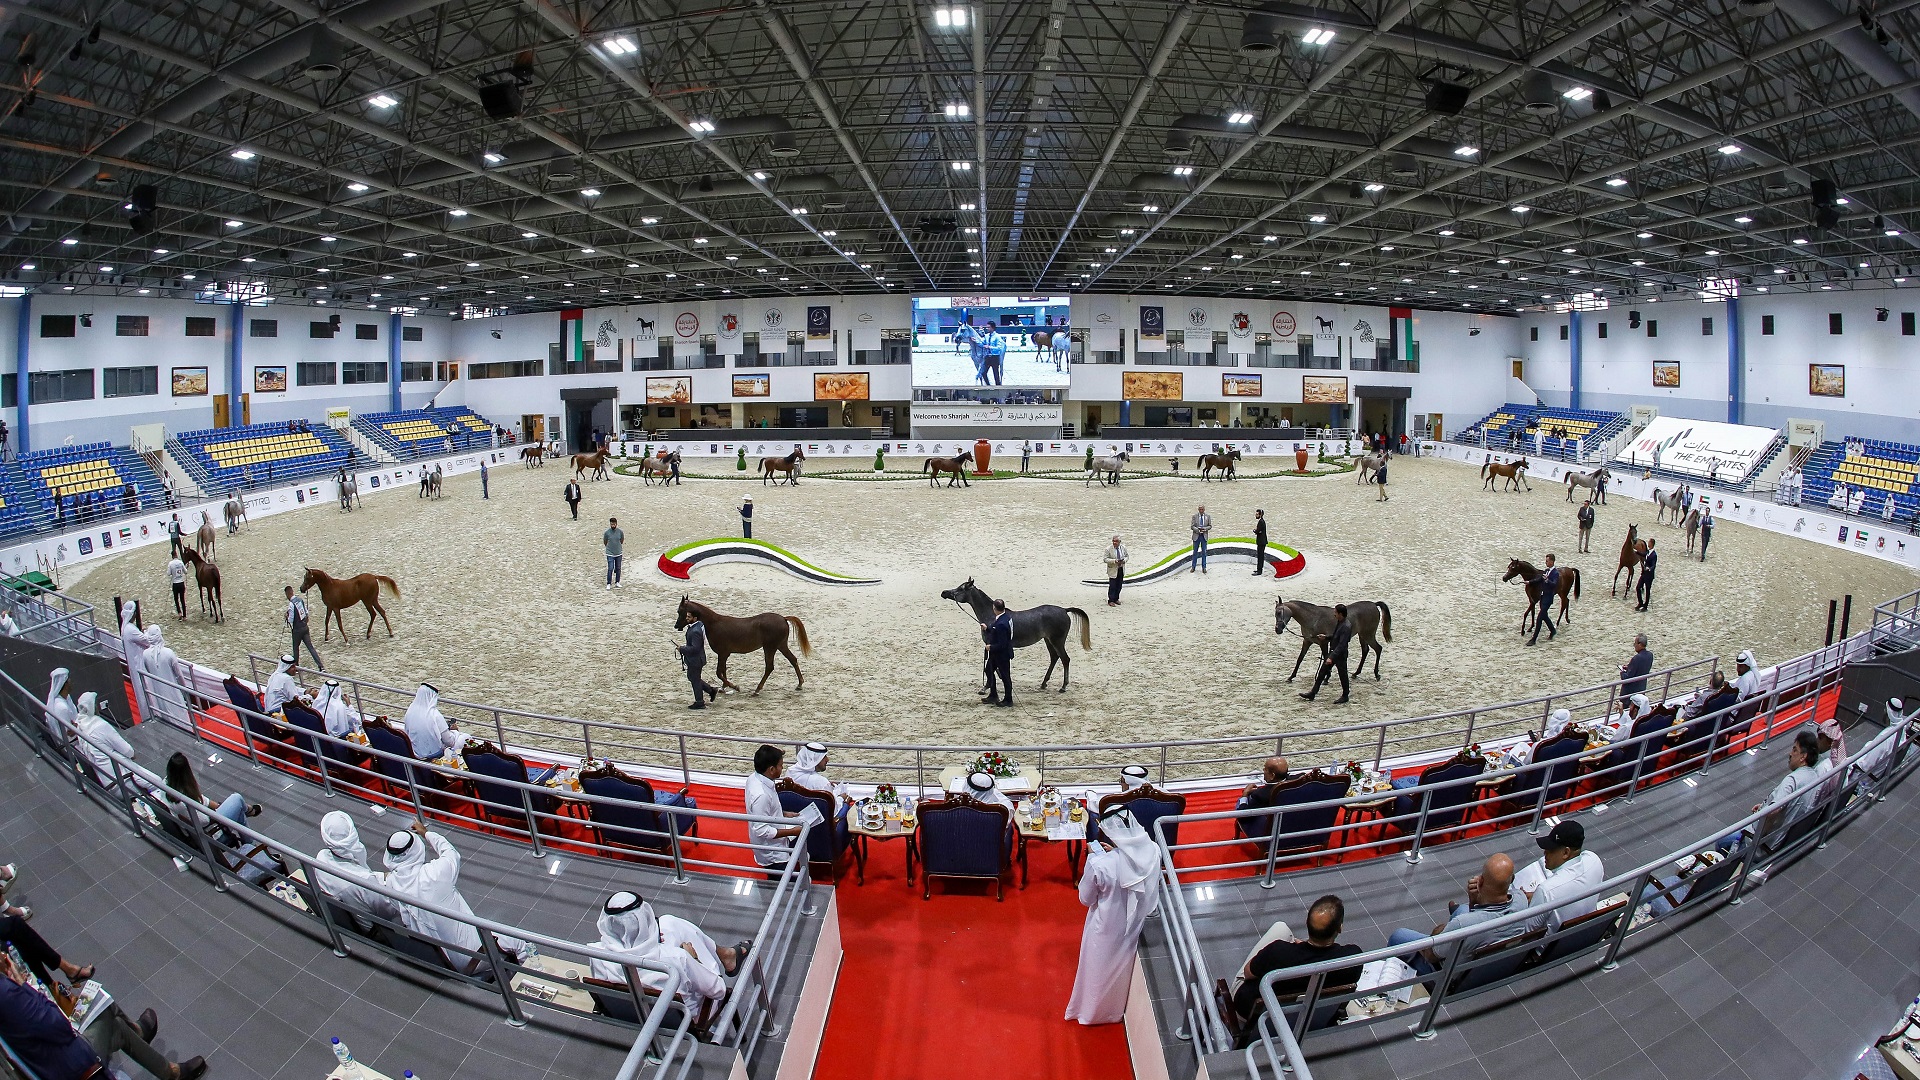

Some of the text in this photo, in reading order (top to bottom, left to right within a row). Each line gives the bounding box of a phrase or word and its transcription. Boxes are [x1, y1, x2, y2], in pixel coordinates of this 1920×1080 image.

[1007, 411, 1058, 422] أهلا بكم في الشارقة
[1683, 441, 1757, 459] الإمارات
[1674, 451, 1747, 470] THE EMATES
[243, 496, 271, 508] ENTRO
